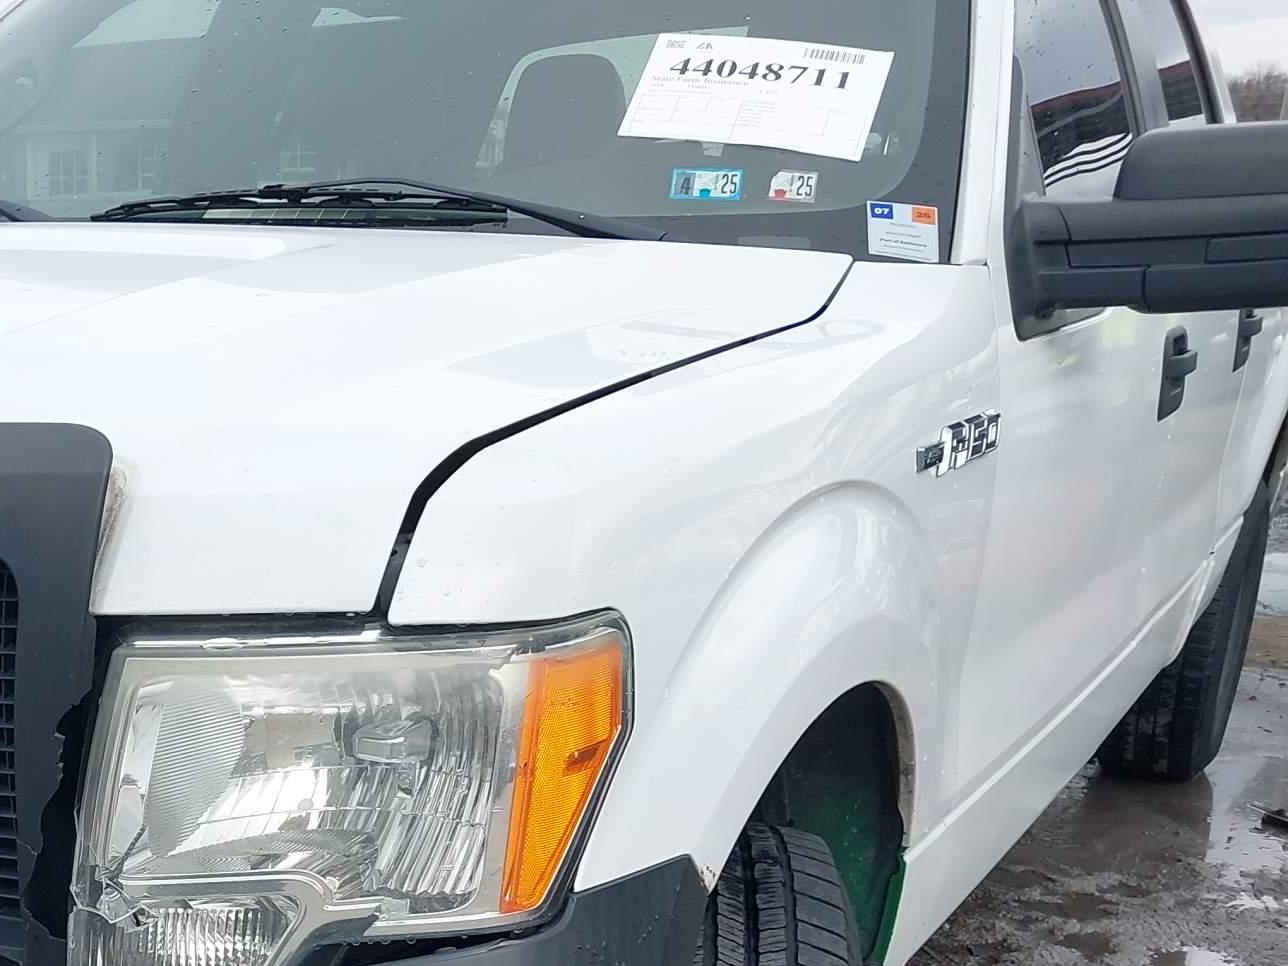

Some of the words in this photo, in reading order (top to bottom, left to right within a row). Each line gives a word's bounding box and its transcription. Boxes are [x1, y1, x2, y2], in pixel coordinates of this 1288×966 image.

[669, 57, 850, 90] 44048711
[680, 176, 691, 195] 4
[721, 173, 738, 194] 25
[796, 175, 813, 197] 25
[874, 207, 890, 215] 07
